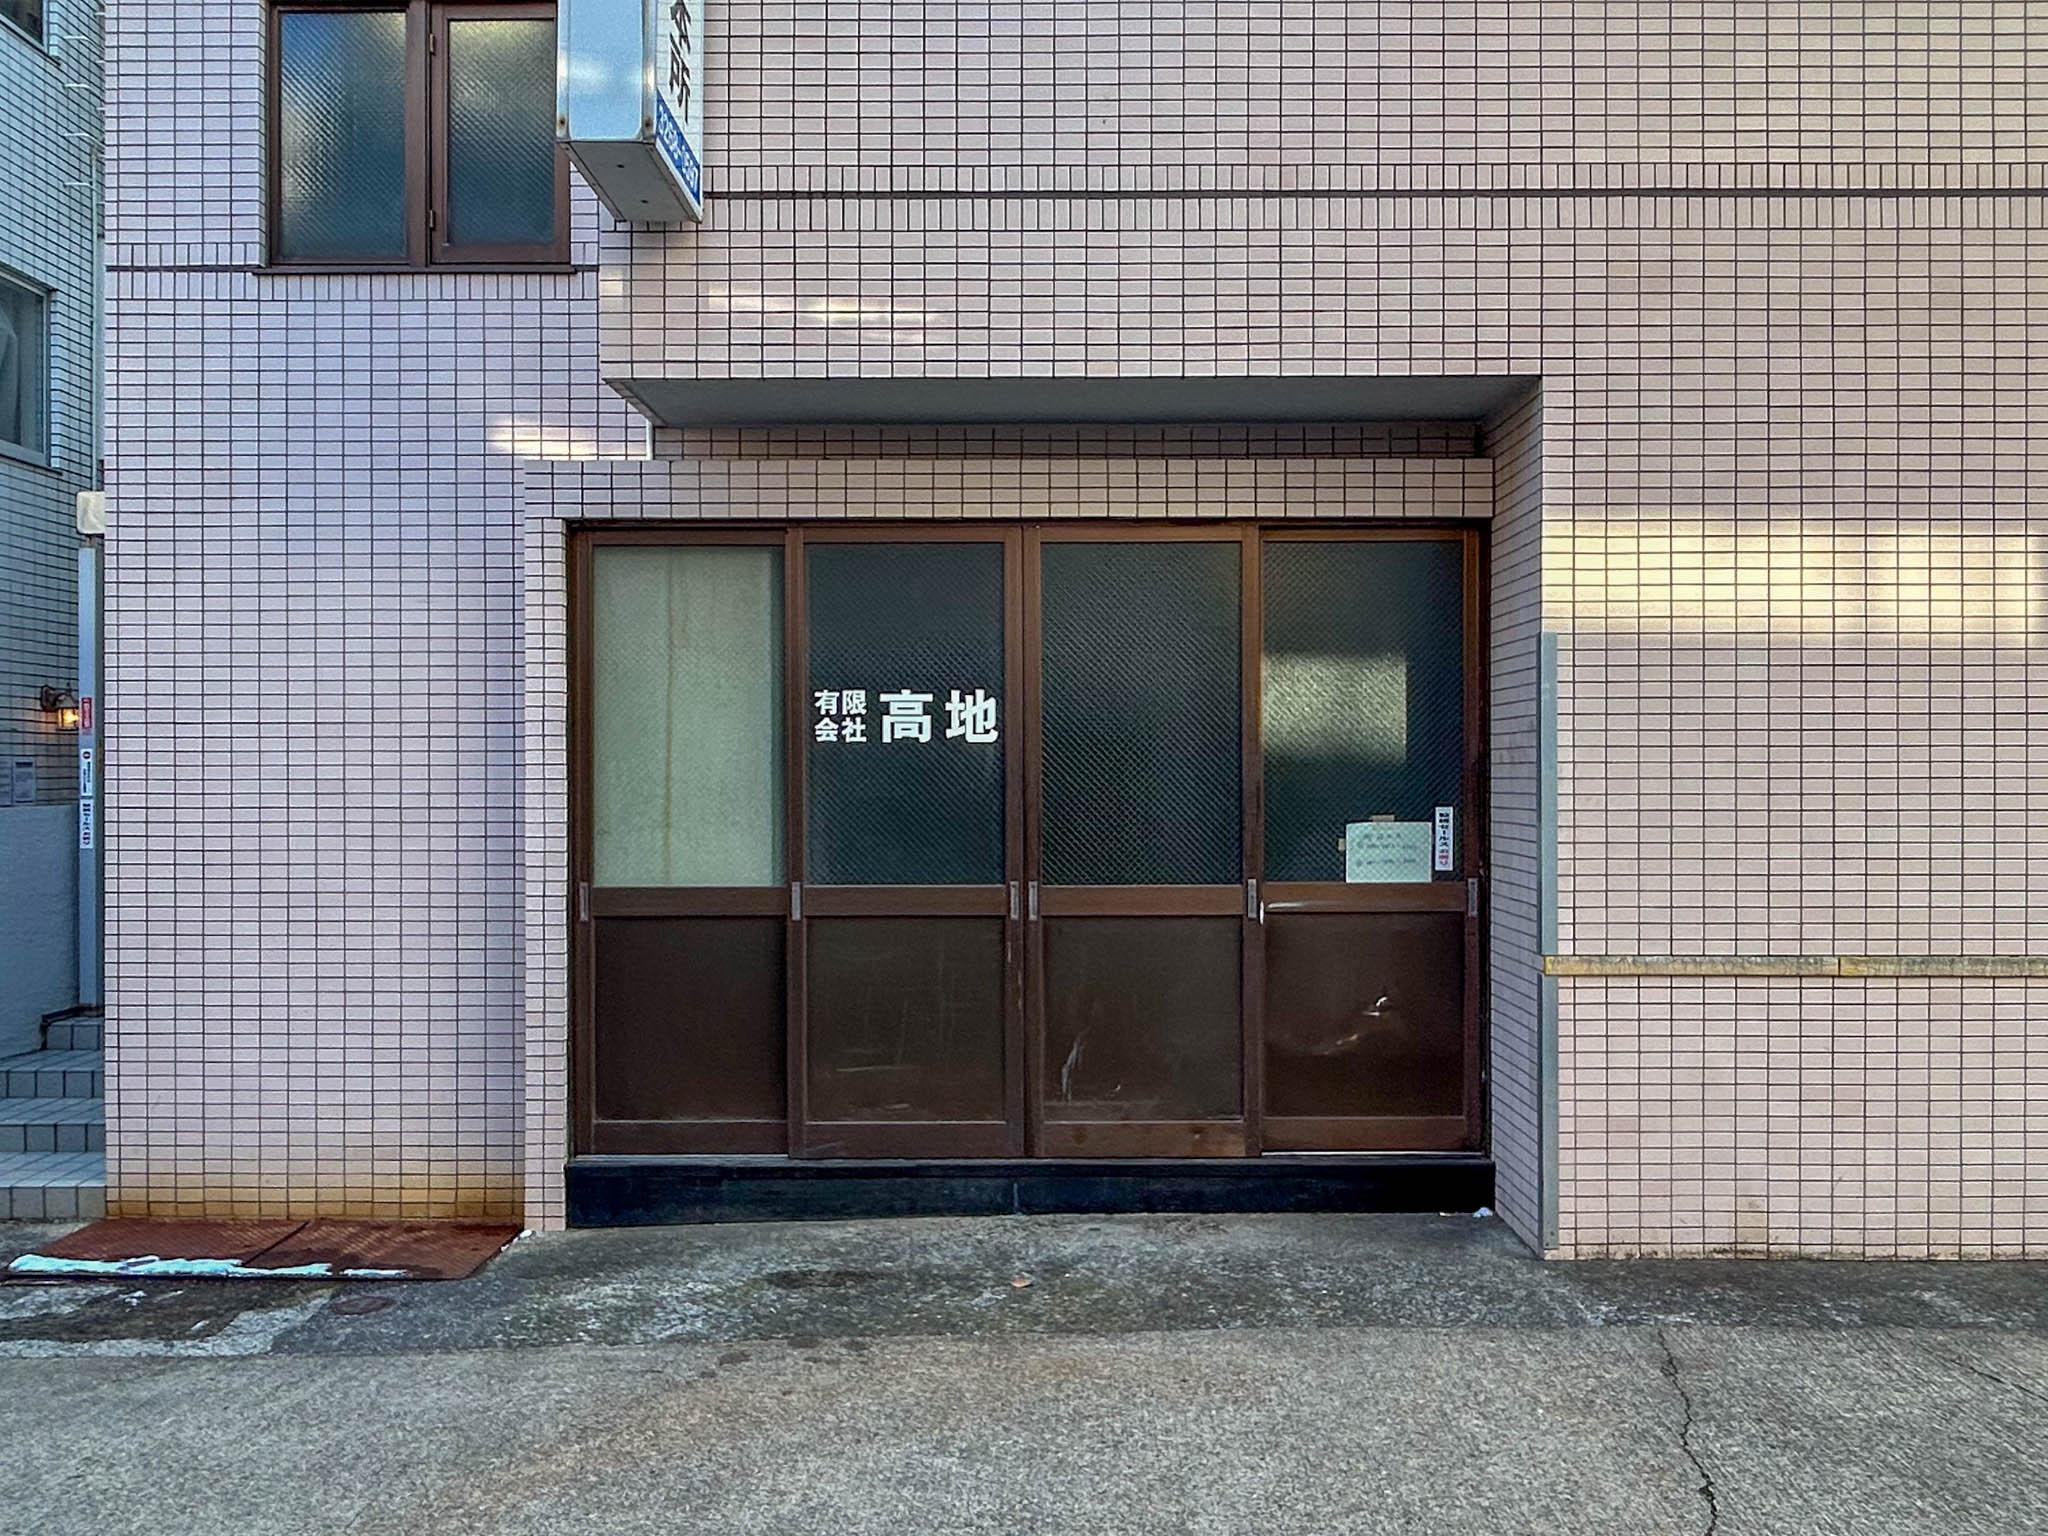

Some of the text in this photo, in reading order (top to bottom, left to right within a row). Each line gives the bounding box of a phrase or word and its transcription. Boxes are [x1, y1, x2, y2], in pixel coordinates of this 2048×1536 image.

[814, 690, 867, 715] 有限
[879, 689, 999, 743] 高地
[814, 717, 867, 742] 会社
